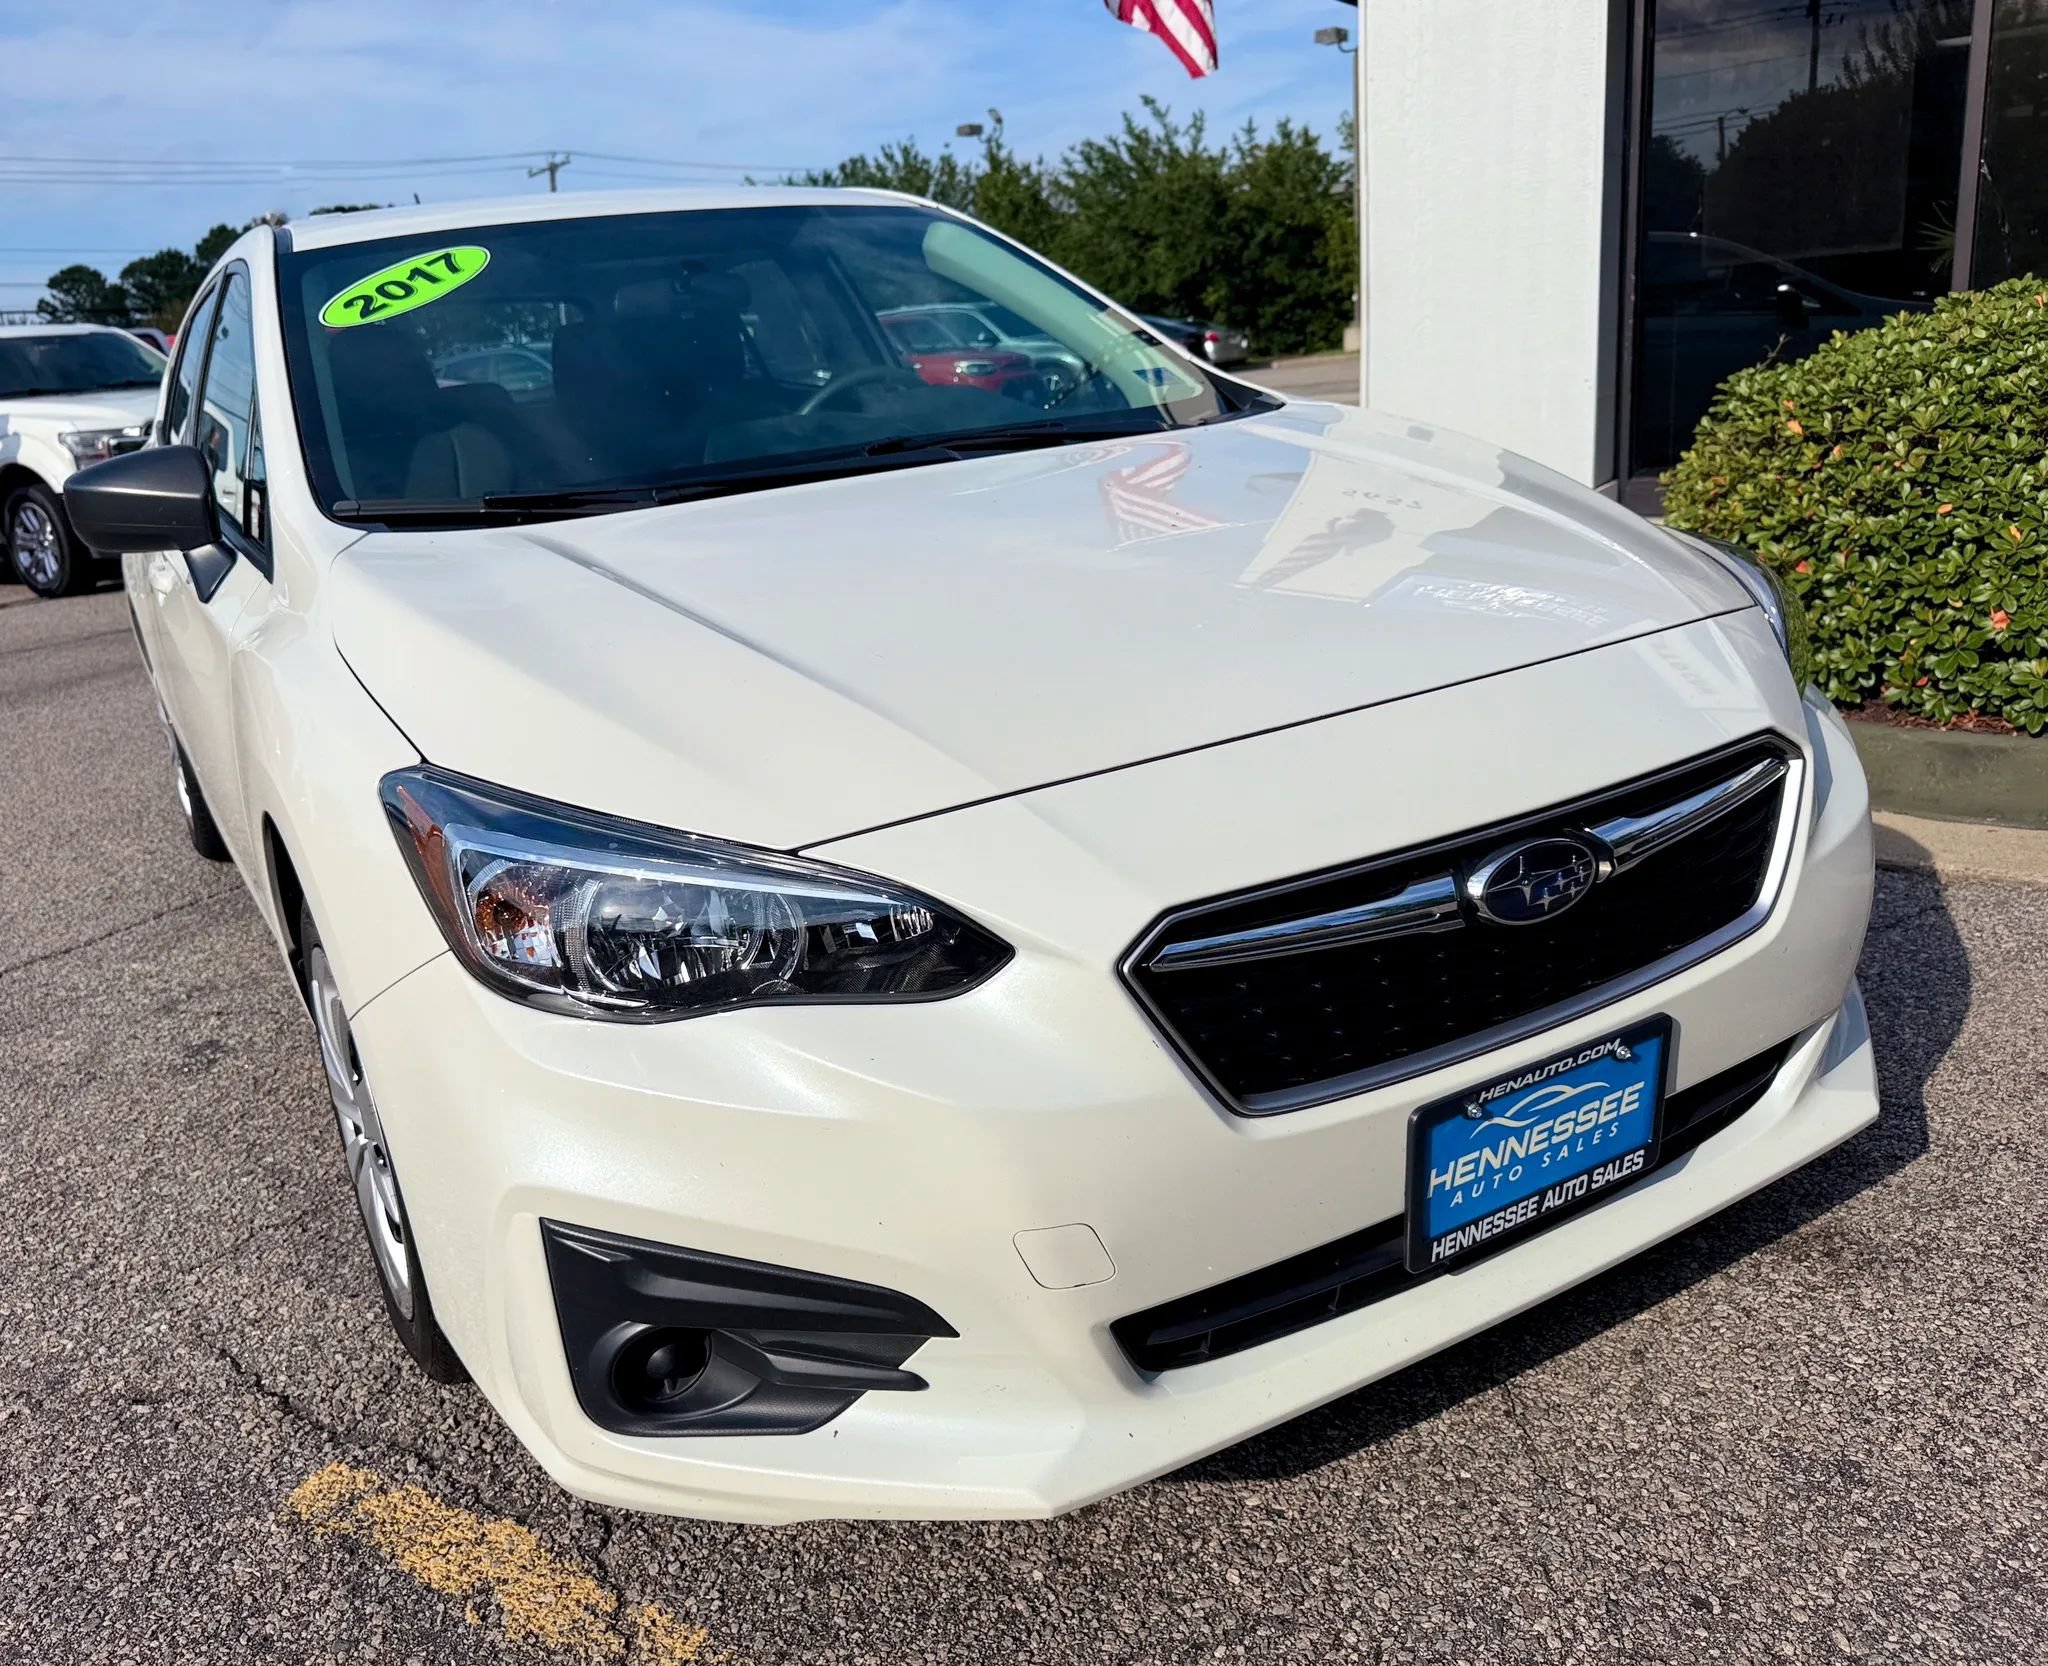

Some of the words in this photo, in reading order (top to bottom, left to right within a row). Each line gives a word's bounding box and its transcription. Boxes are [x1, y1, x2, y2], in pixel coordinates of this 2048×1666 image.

[343, 252, 463, 319] 2017
[1478, 1037, 1621, 1104] HENAUTO.COM
[1427, 1081, 1645, 1198] HENNESSEE
[1450, 1164, 1522, 1208] AUTO
[1541, 1121, 1620, 1168] SALES
[1431, 1198, 1540, 1263] HENNESSEE
[1541, 1173, 1589, 1213] AUTO
[1590, 1149, 1645, 1193] SALES
